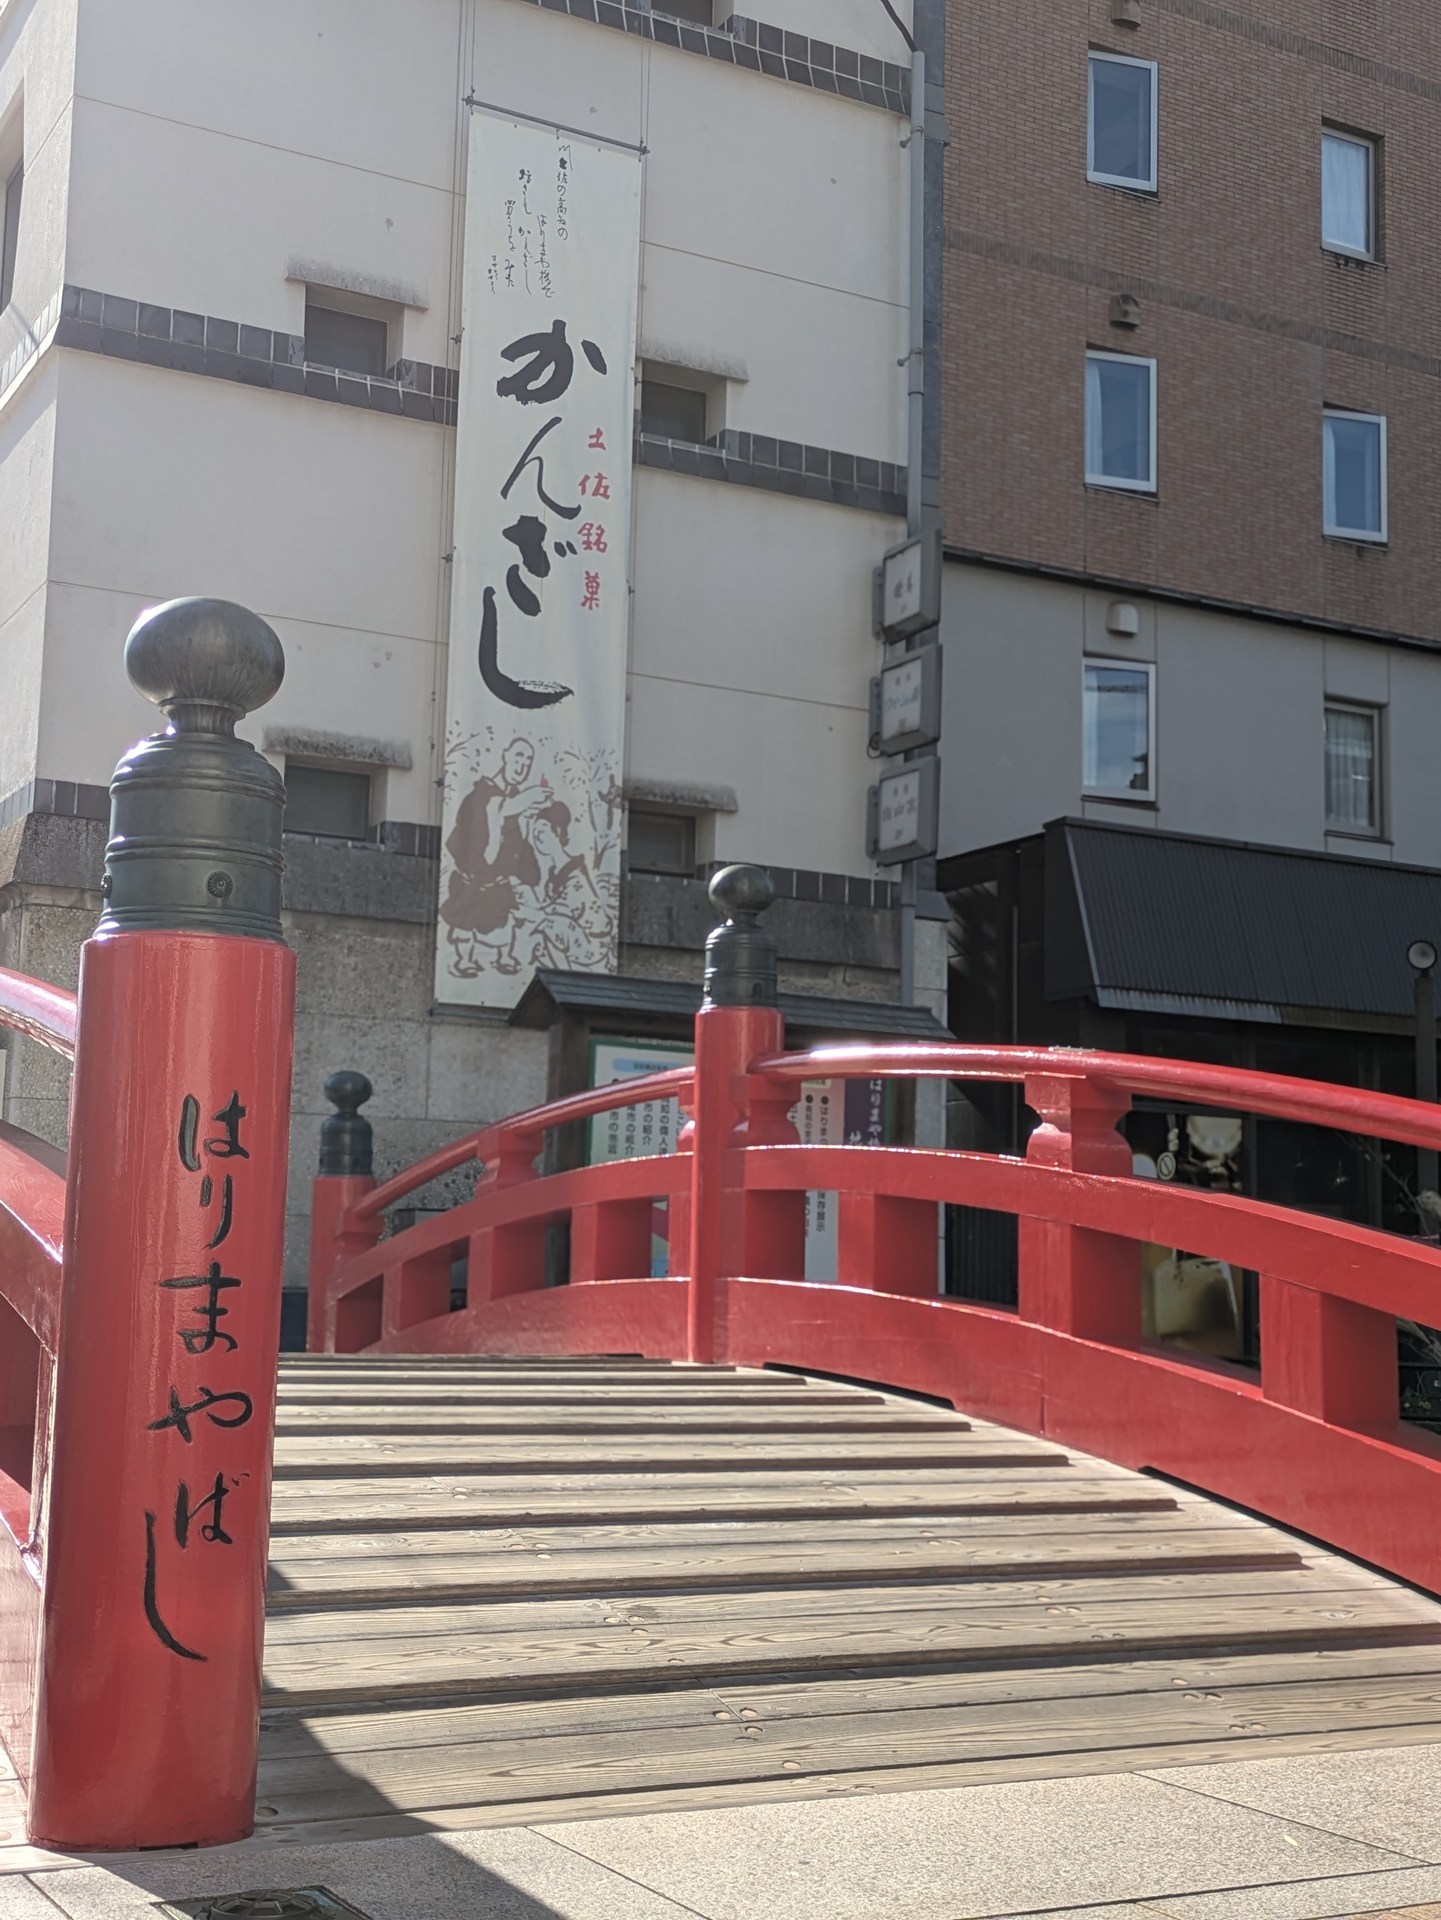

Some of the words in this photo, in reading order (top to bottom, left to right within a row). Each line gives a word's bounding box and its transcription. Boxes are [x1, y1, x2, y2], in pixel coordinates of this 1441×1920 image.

[478, 319, 608, 710] かんざし
[577, 427, 611, 611] 土佐銘菓
[144, 1089, 253, 1662] はりまやばし
